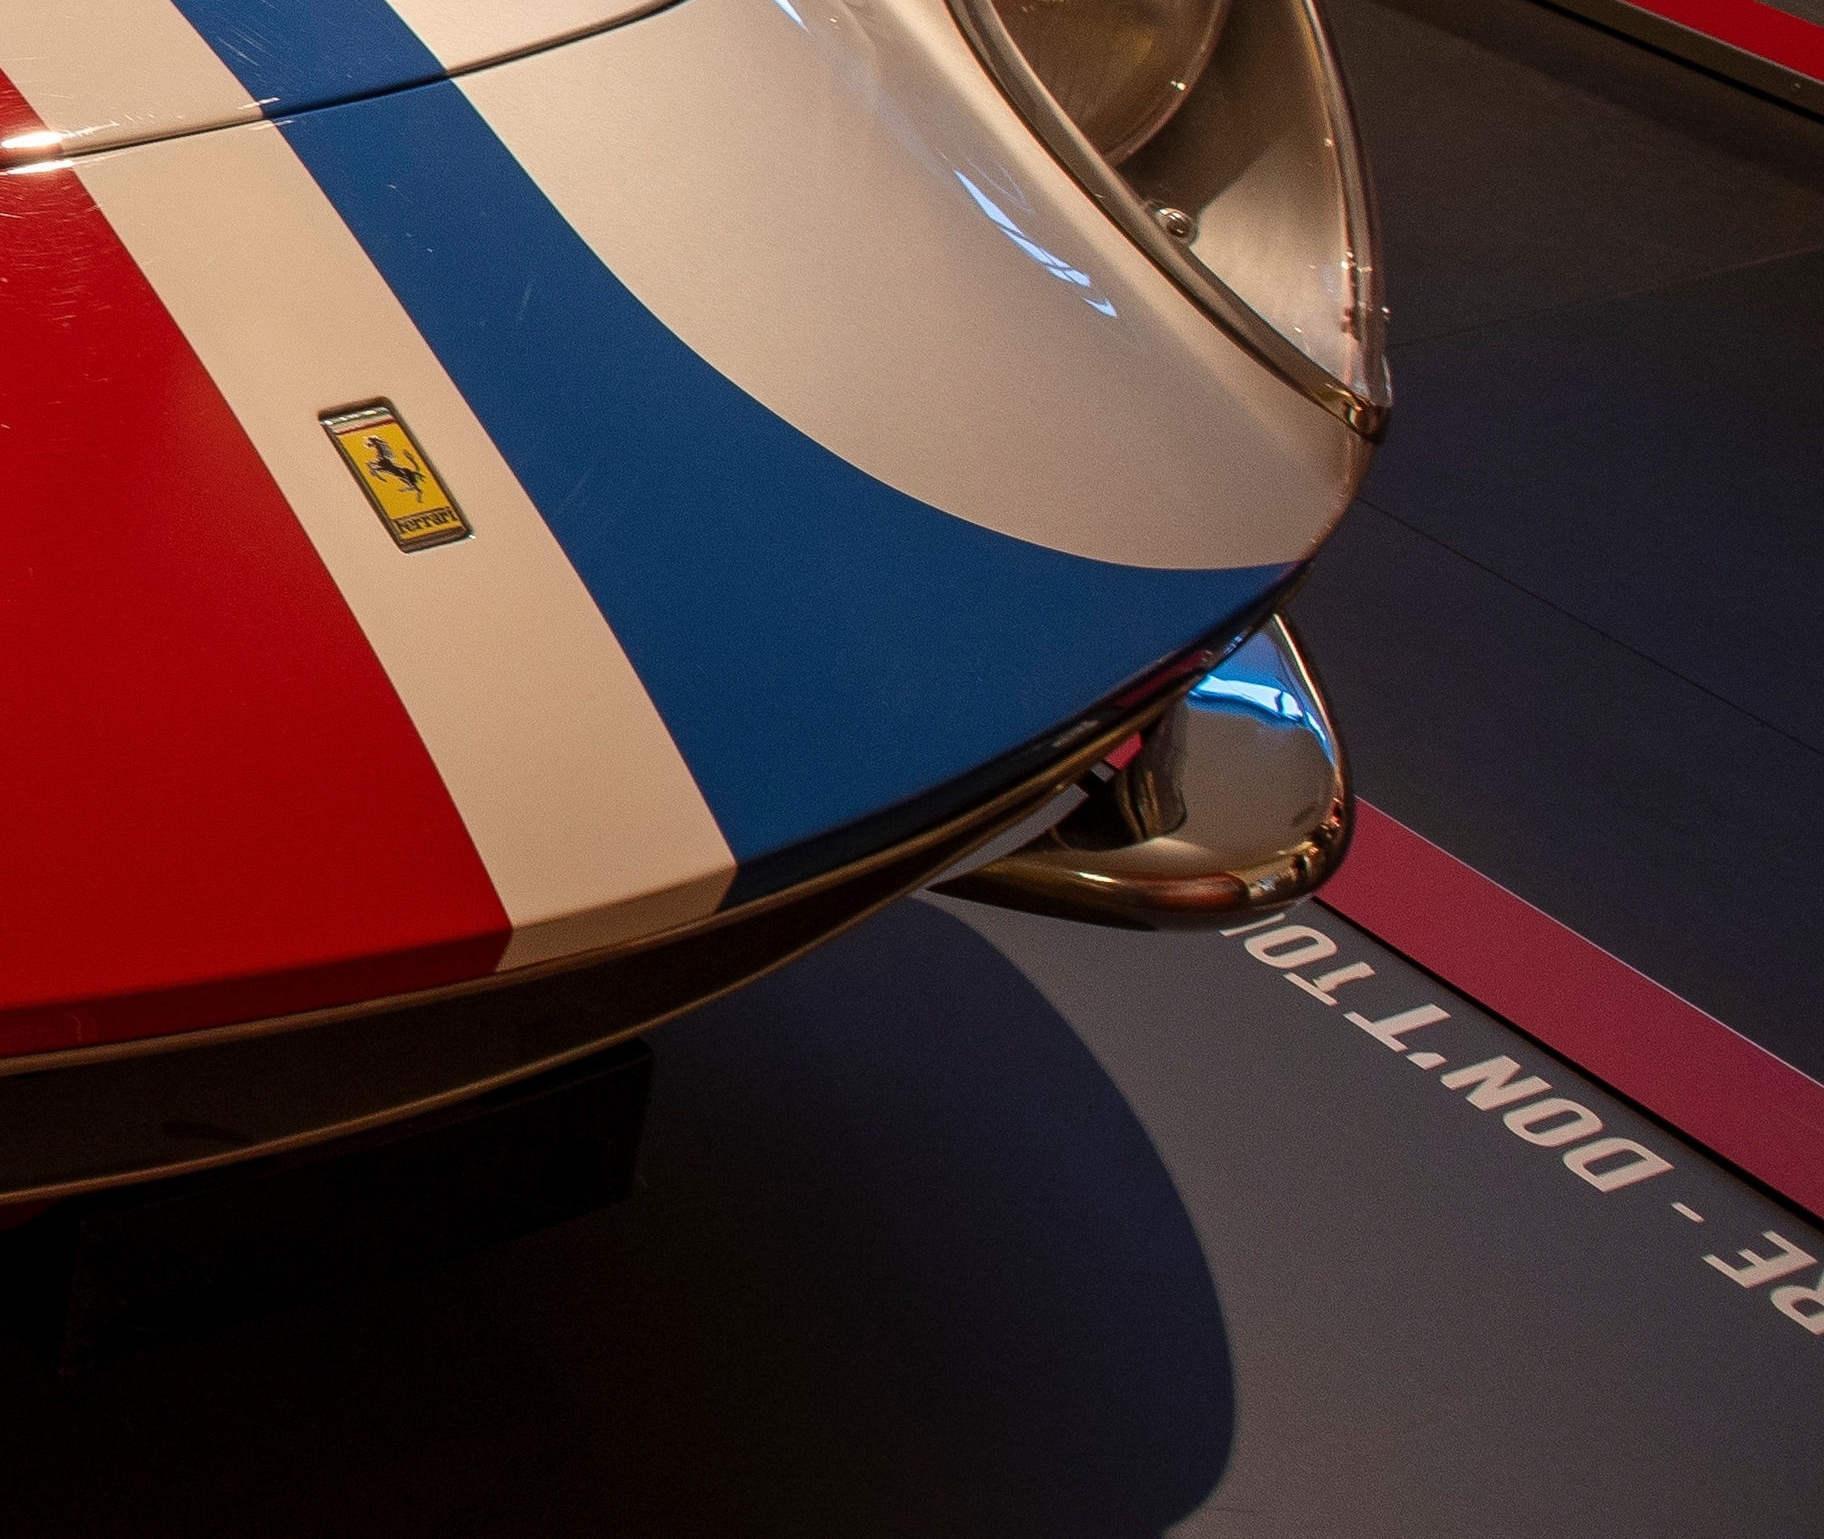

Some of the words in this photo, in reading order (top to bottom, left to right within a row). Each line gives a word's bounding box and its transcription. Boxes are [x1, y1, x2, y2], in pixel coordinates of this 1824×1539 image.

[390, 506, 459, 534] Ferrari
[1219, 913, 1376, 1007] TO
[1342, 1003, 1675, 1193] DON'T
